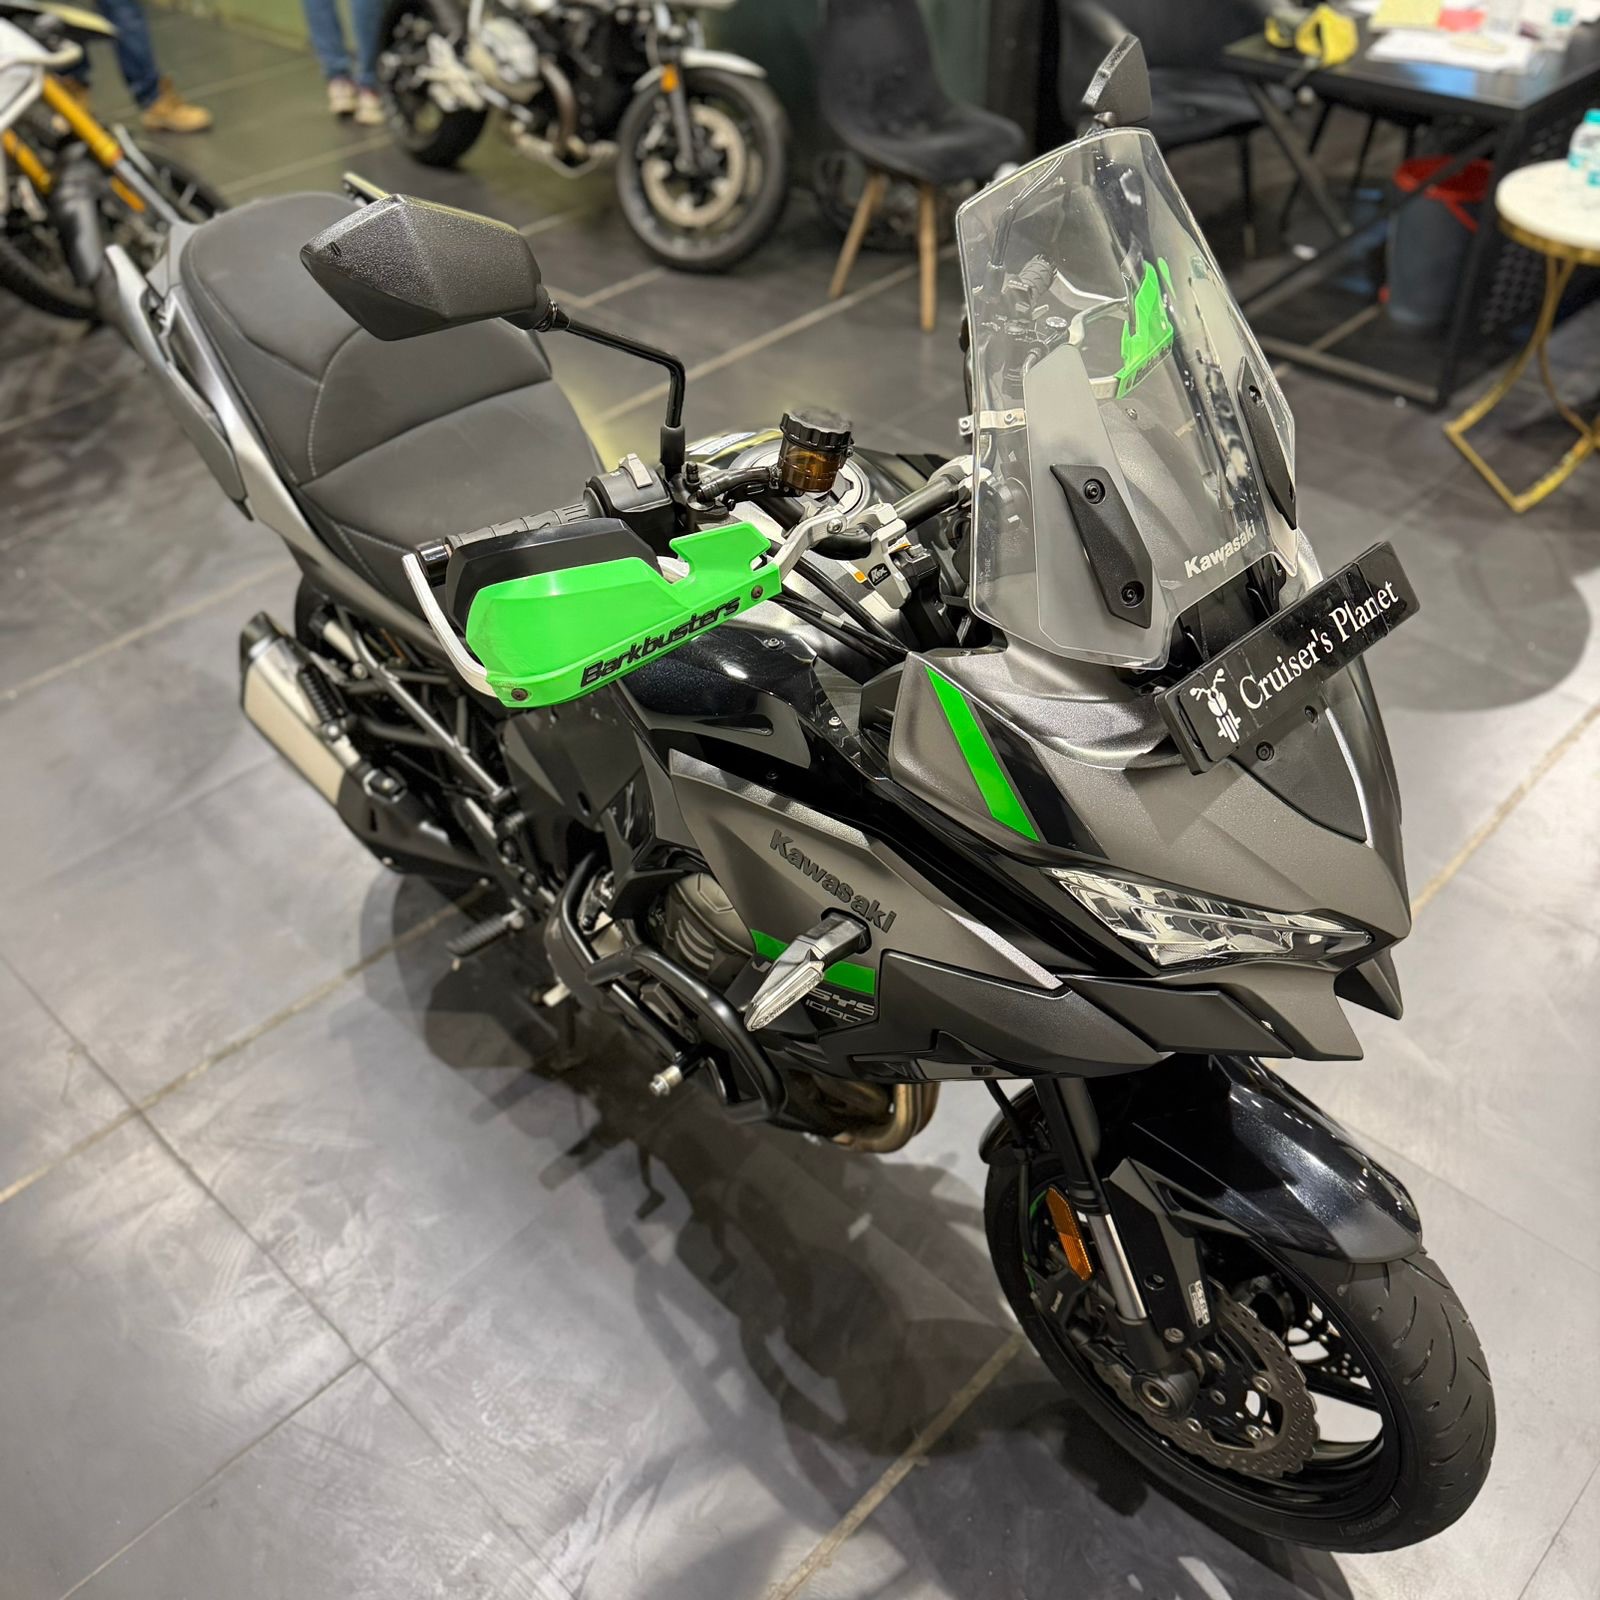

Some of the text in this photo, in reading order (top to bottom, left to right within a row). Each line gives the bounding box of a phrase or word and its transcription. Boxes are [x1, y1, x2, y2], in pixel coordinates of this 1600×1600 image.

[1184, 519, 1257, 578] Kawasaki
[580, 597, 741, 688] Barkbusters
[1239, 581, 1399, 710] Cruiser's Planet
[769, 829, 898, 934] Kawasaki
